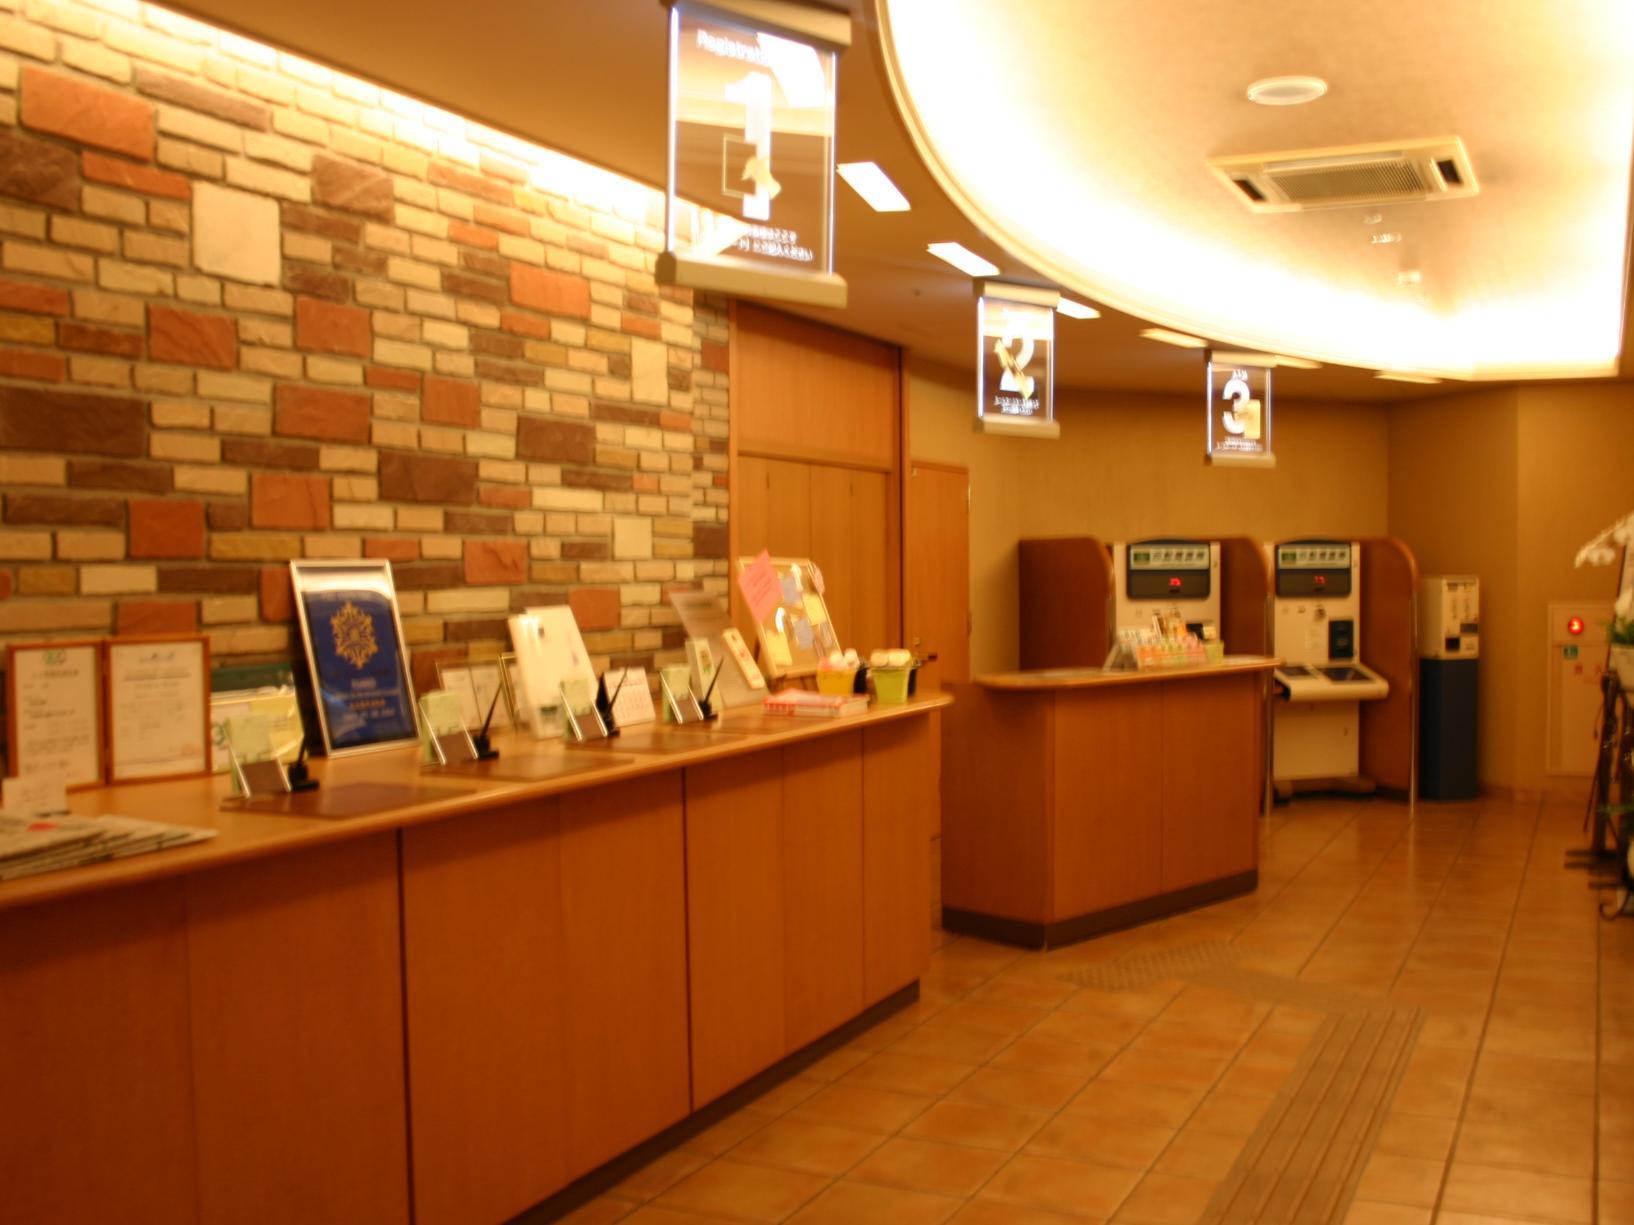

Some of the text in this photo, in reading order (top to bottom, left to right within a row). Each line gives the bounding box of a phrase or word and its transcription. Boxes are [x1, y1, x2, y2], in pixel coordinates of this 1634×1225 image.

[725, 71, 771, 221] 1
[999, 321, 1035, 393] 2
[1222, 379, 1250, 435] 3
